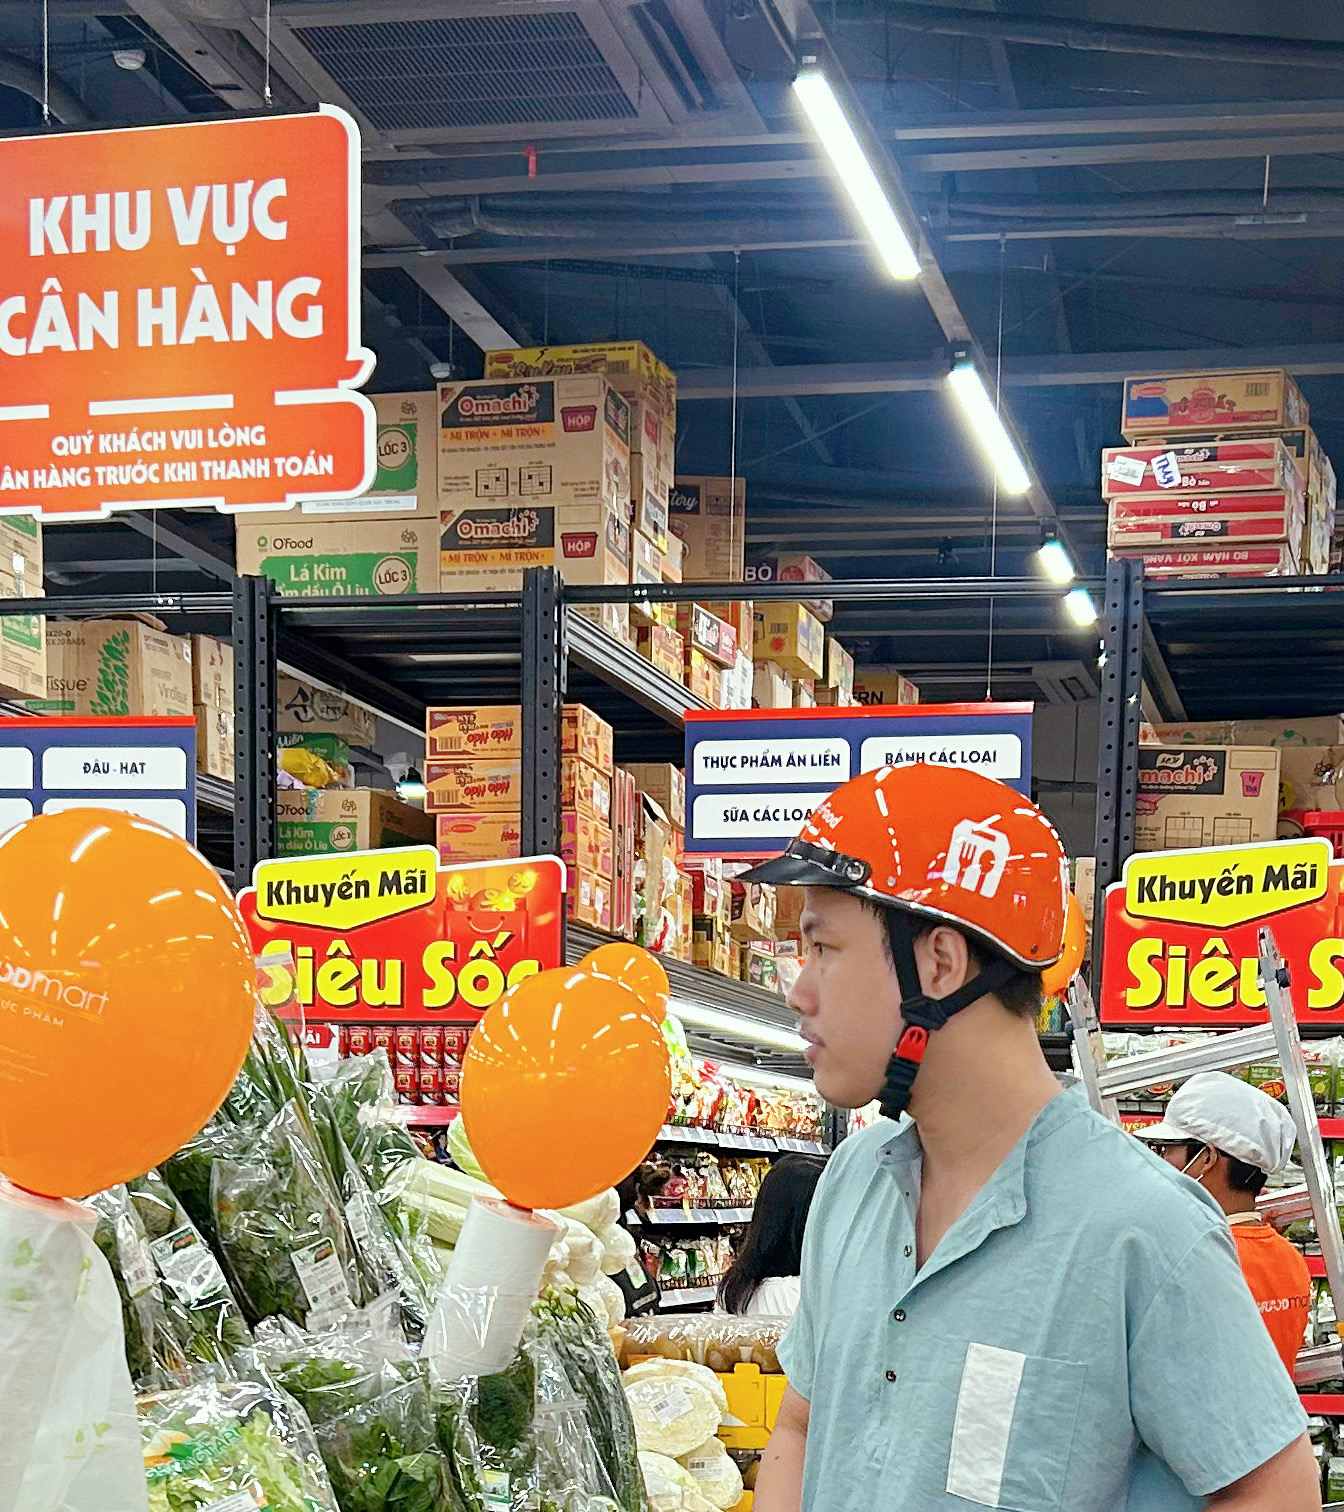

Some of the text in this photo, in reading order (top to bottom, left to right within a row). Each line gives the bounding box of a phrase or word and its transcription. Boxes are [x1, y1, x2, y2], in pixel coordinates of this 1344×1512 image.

[29, 178, 287, 257] KHU VỰC
[137, 268, 323, 348] HÀNG
[459, 390, 530, 415] Omachi
[52, 424, 266, 457] QUÝ KHÁCH VUI LÒNG
[378, 438, 408, 457] LỐC 3
[34, 460, 91, 489] HÀNG
[95, 458, 159, 486] TRƯỚC
[164, 462, 197, 483] KHI
[201, 460, 271, 482] THANH
[275, 449, 333, 478] TOÁN
[458, 517, 530, 539] Omachi
[566, 540, 592, 555] HỘP
[289, 563, 309, 580] Lá
[378, 570, 407, 585] LỐC 3
[745, 565, 772, 581] BÒ
[703, 748, 840, 773] THỰC PHẨM ĂN LIỀN
[929, 747, 957, 763] CÁC
[961, 749, 997, 767] LOẠI
[83, 761, 146, 777] ĐẬU HẠT
[1138, 766, 1203, 784] machi
[722, 805, 750, 824] SỮA
[754, 803, 781, 822] CÁC
[279, 828, 314, 838] Lá Kim
[315, 842, 328, 850] Liu
[267, 868, 426, 908] Khuyến Mãi
[1138, 861, 1318, 904] Khuyến Mãi
[261, 938, 402, 1008] Siêu
